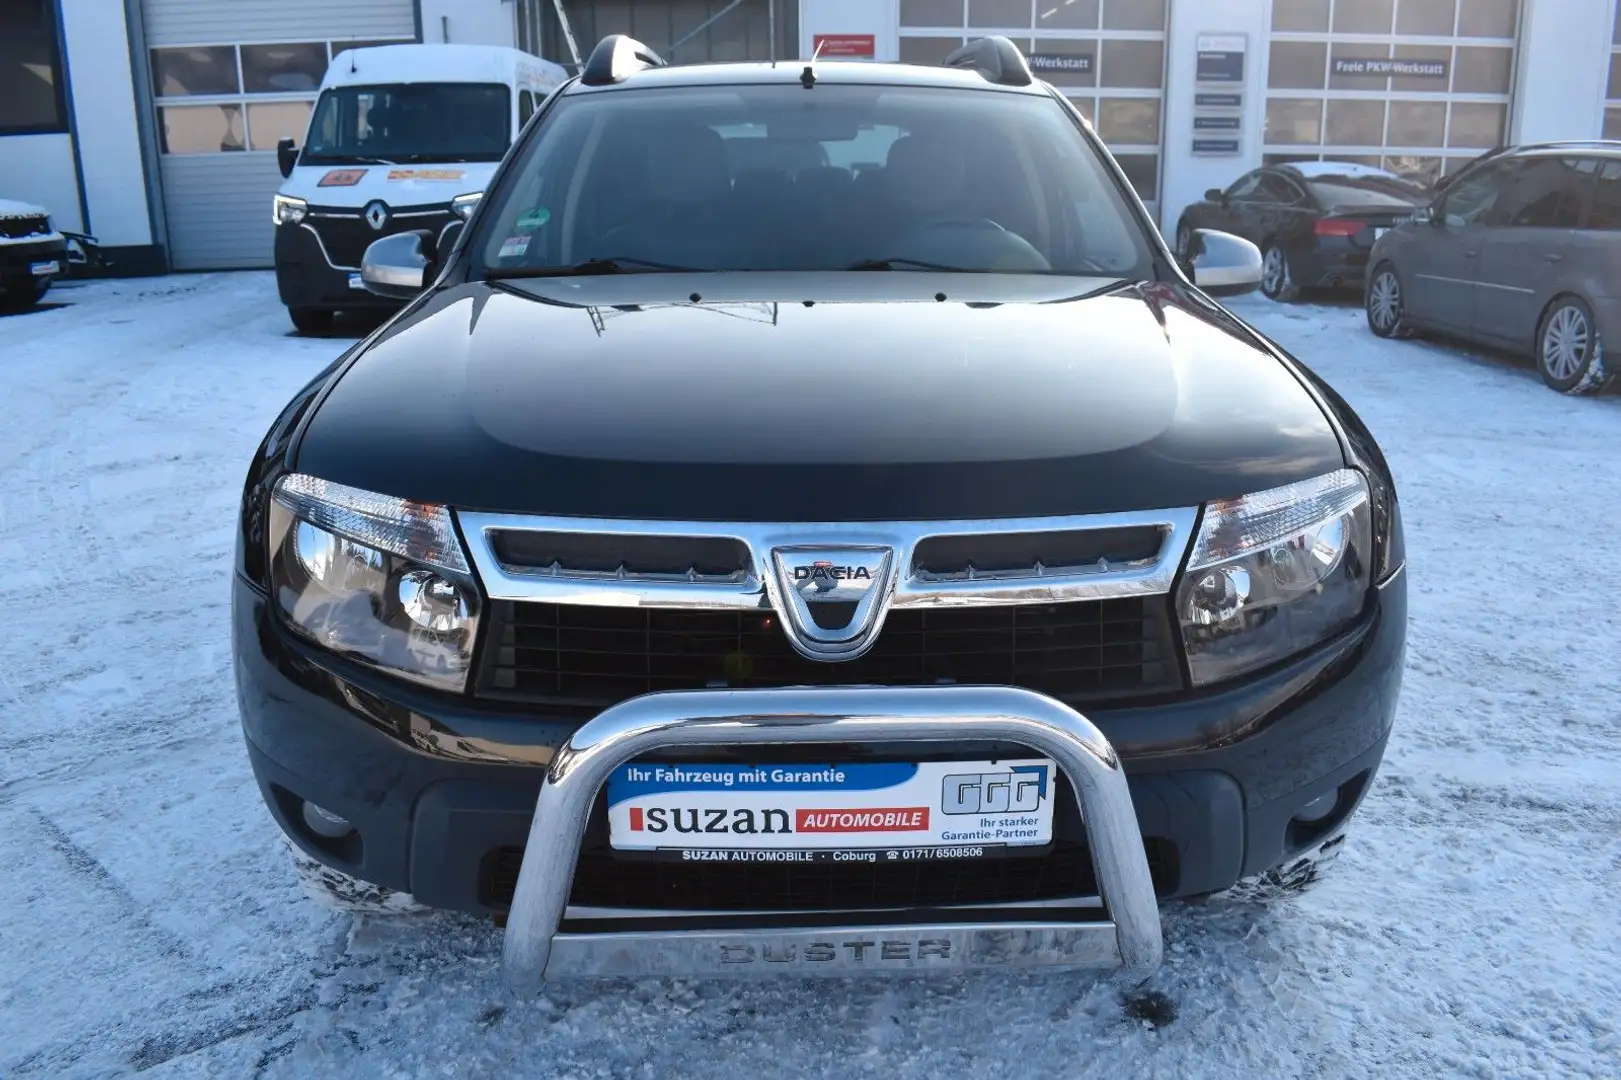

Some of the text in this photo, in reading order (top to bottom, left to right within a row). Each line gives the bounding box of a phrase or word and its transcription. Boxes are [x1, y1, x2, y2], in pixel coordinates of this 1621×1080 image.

[1336, 61, 1445, 74] Freie PKW-Werkstatt
[794, 566, 871, 580] DACIA
[627, 768, 845, 786] Ihr Fahrzeug mit Garantie
[646, 807, 922, 834] suzan AUTOMOBILE
[980, 816, 1040, 828] Ihr starker
[941, 828, 1039, 841] Garantie-Partner
[682, 847, 983, 862] SUZAN AUTOMOBILE Coburg 0171/6508506
[720, 939, 951, 964] DUSTER
